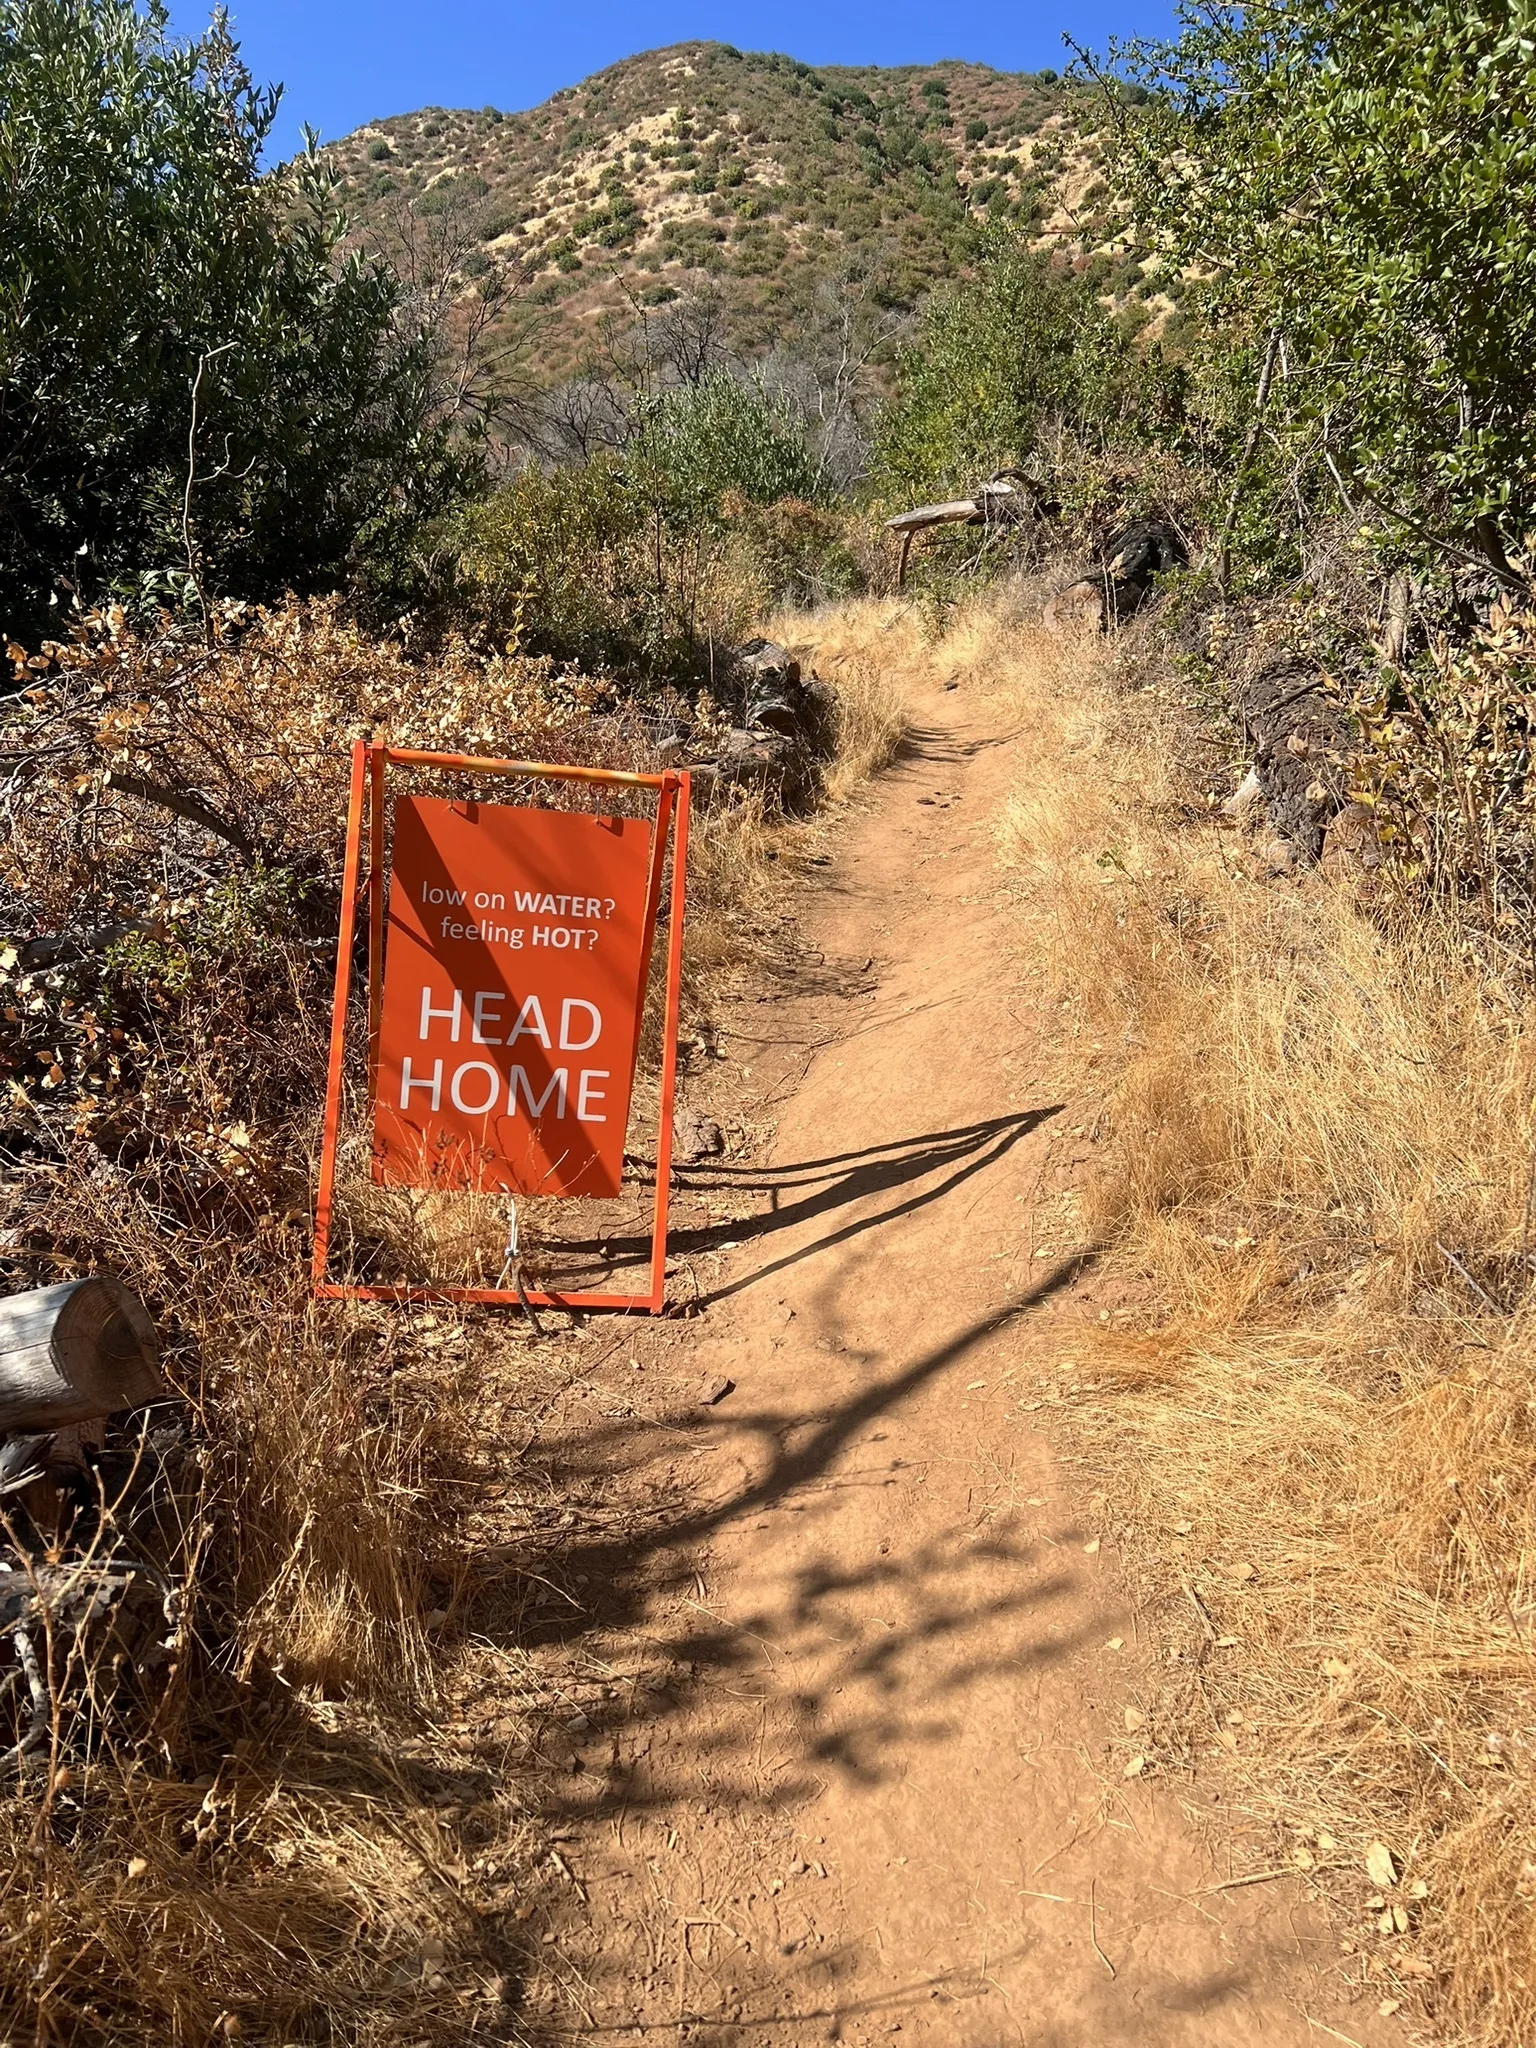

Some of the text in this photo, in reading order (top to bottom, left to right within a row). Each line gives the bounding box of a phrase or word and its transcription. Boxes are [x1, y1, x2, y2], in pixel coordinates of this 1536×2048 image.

[421, 880, 616, 920] low on WATER?
[441, 916, 599, 950] feeling HOT?
[419, 986, 602, 1051] HEAD
[399, 1056, 610, 1122] HOME
